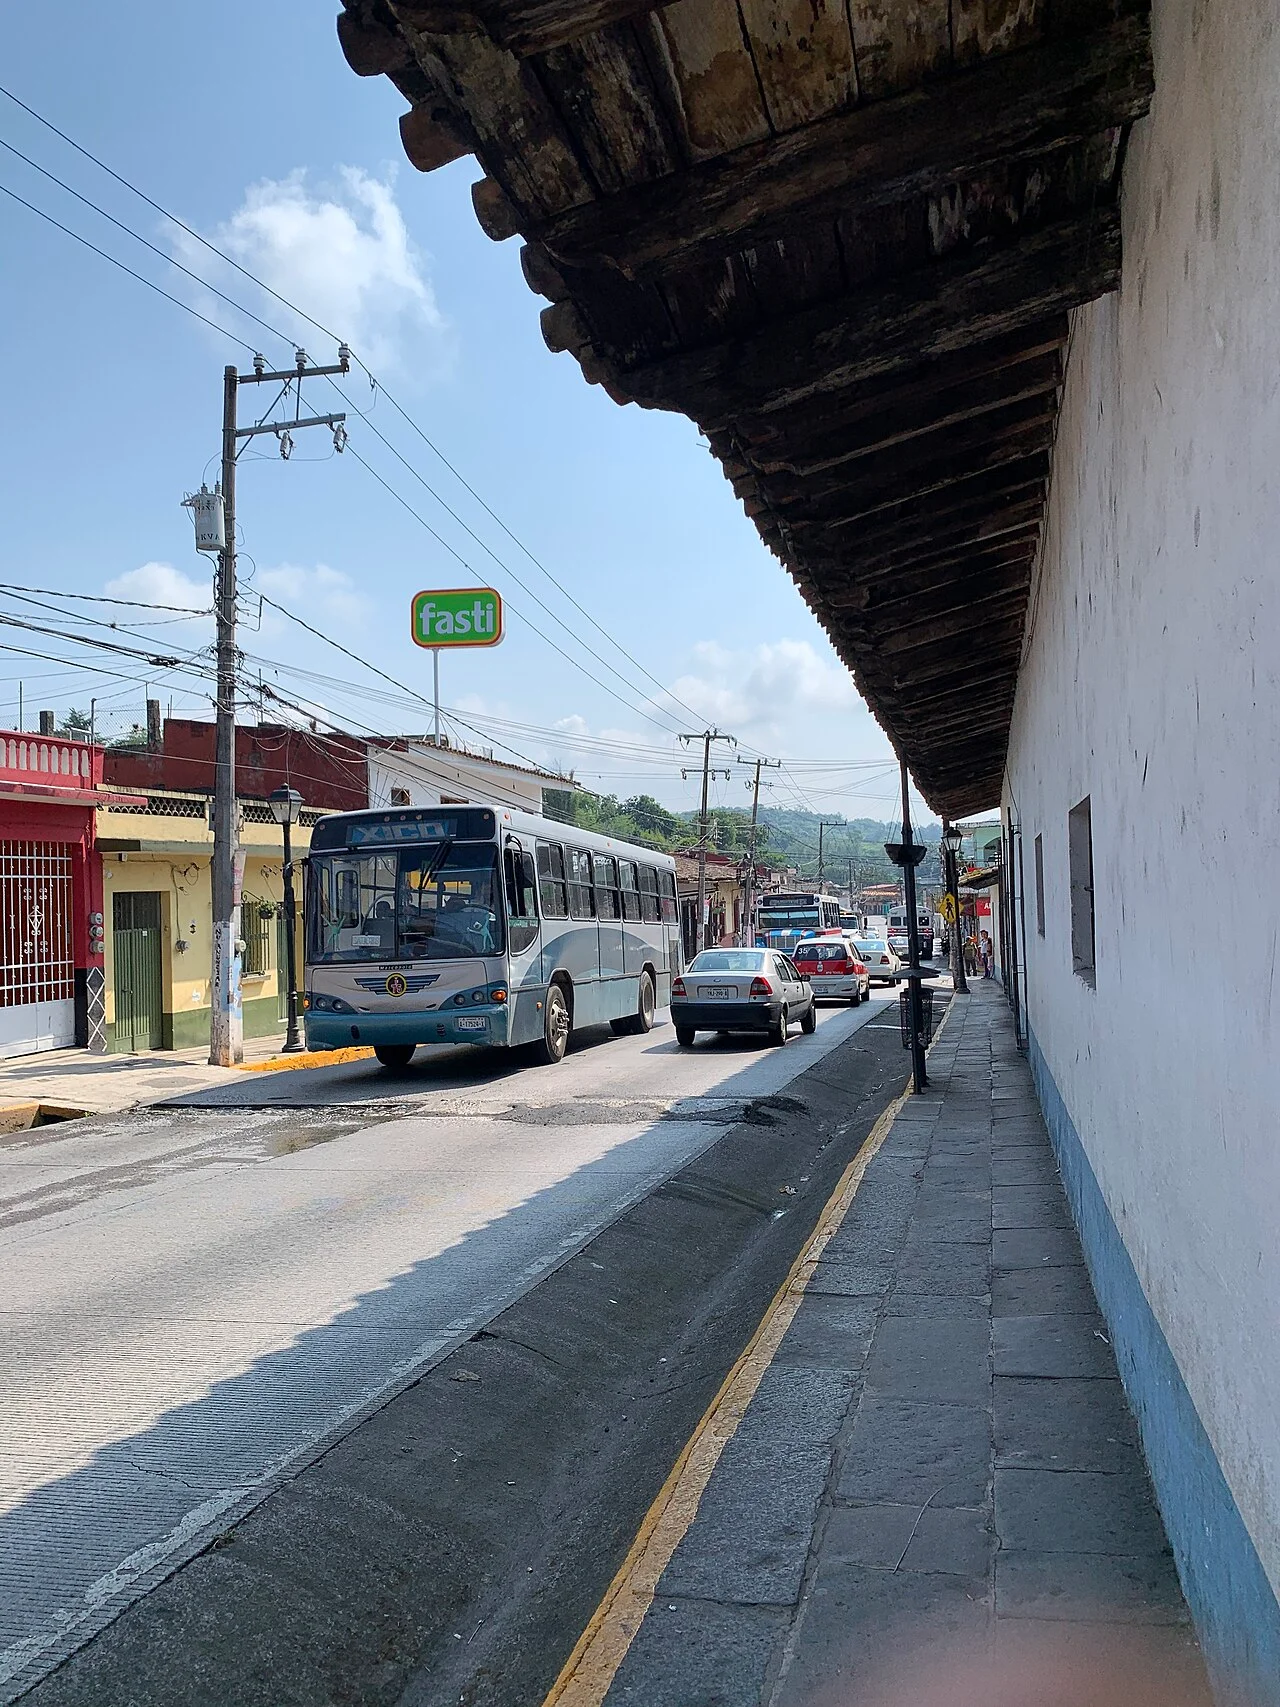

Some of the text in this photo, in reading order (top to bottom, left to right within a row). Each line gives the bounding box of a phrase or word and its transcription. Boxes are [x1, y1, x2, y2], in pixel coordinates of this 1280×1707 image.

[200, 533, 220, 541] KVA
[419, 600, 494, 635] fasti
[355, 822, 446, 842] XICO
[797, 947, 808, 955] 35
